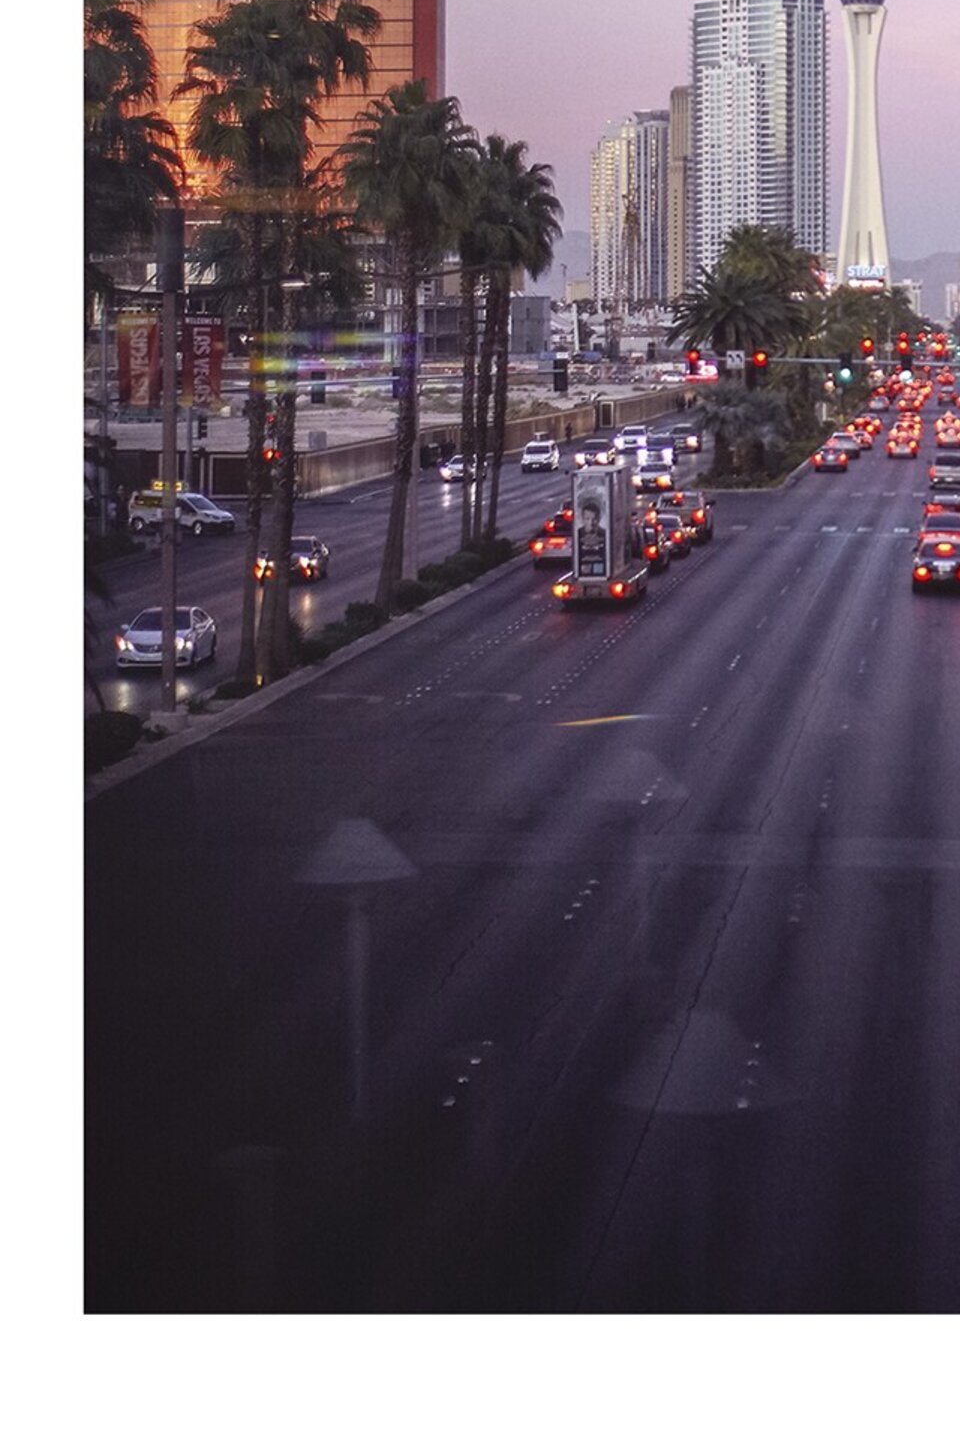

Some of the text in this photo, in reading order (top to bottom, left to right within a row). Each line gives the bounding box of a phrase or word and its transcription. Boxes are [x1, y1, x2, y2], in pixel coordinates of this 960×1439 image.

[847, 265, 886, 277] STRAT
[130, 327, 149, 405] LAS VEGAS
[193, 327, 212, 403] LAS VEGAS
